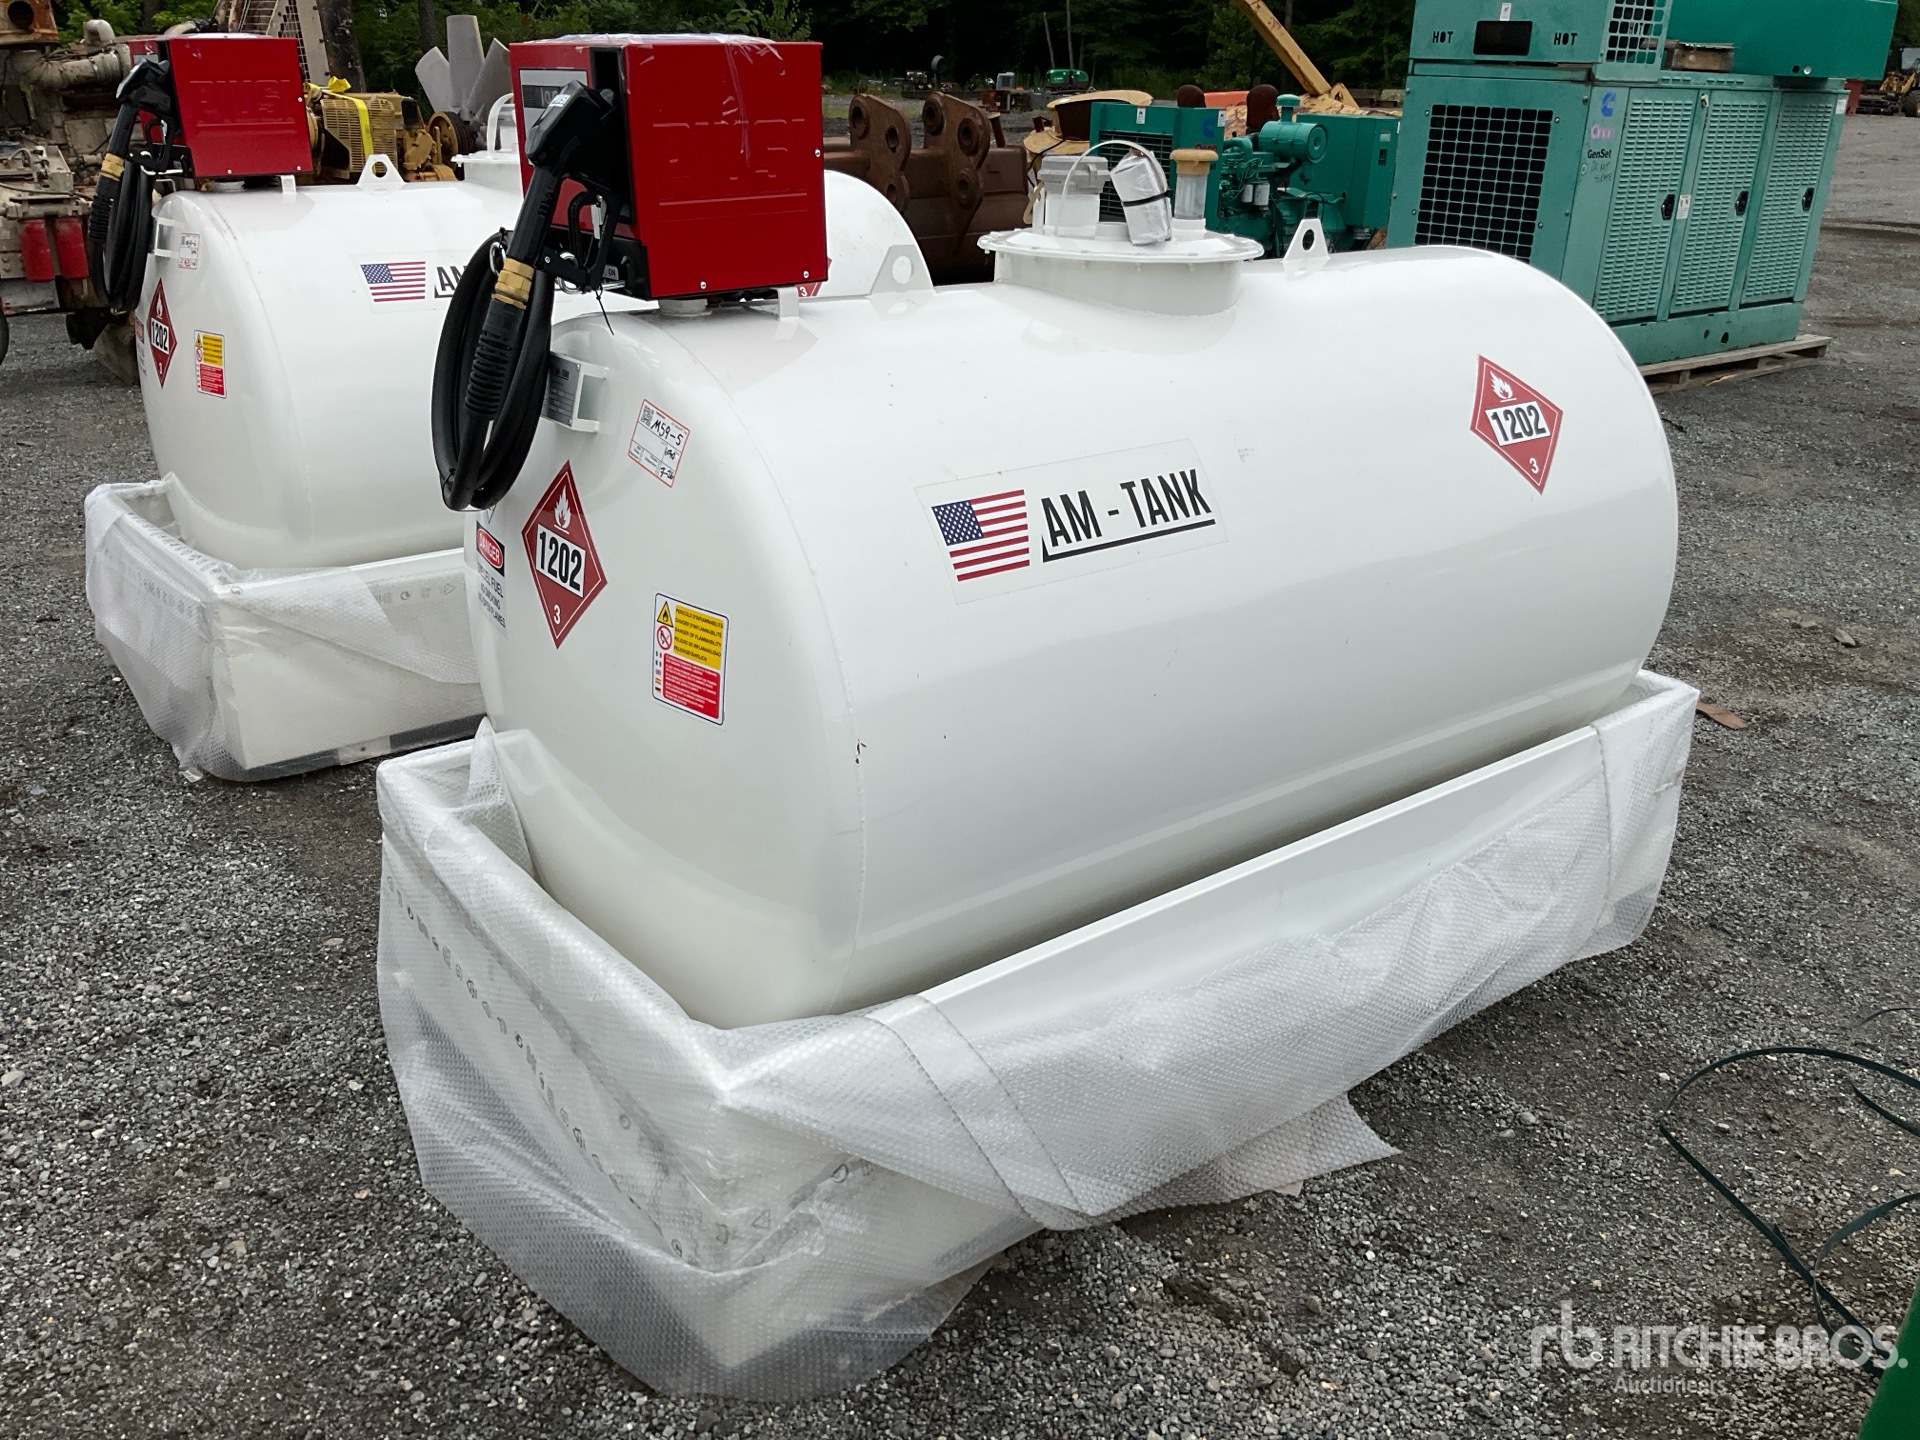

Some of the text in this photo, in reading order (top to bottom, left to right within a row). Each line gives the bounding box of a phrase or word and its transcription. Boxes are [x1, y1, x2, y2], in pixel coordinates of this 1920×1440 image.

[1432, 31, 1453, 43] HOT
[1553, 32, 1578, 45] HOT
[151, 320, 168, 351] 1202
[158, 362, 163, 374] 3
[650, 419, 684, 446] M59-5
[1490, 404, 1547, 441] 1202
[1529, 457, 1539, 474] 3
[1041, 490, 1102, 547] AM
[1120, 469, 1212, 528] TANK
[539, 530, 582, 592] 1202
[490, 576, 504, 598] FUEL
[553, 604, 561, 624] 3
